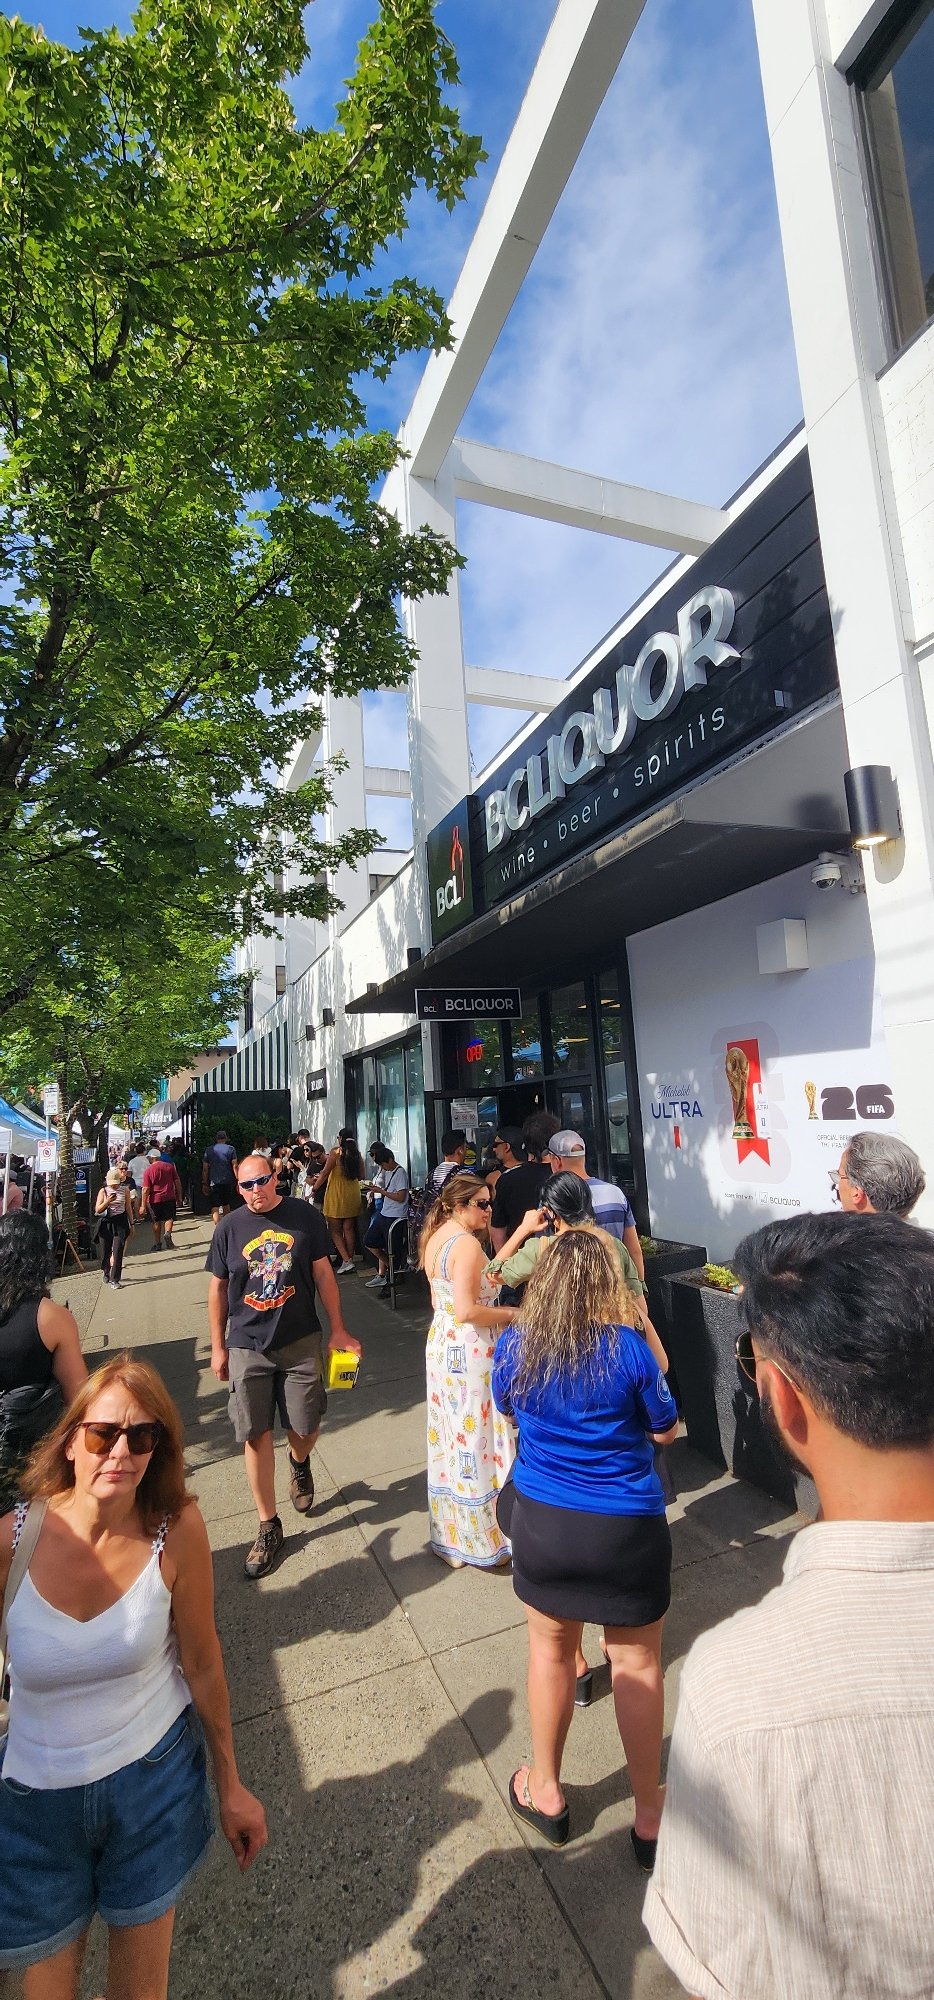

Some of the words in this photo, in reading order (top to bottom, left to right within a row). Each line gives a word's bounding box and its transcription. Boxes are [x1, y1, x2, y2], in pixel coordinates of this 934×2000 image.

[485, 585, 741, 853] BCLIQUOR
[501, 846, 535, 882] wine
[558, 797, 601, 841] beer
[634, 706, 726, 787] spirits
[436, 875, 462, 918] BCL
[445, 998, 514, 1011] BCLIQUOR
[656, 1084, 691, 1100] Michelob
[650, 1100, 704, 1119] ULTRA
[866, 1105, 886, 1114] FIFA
